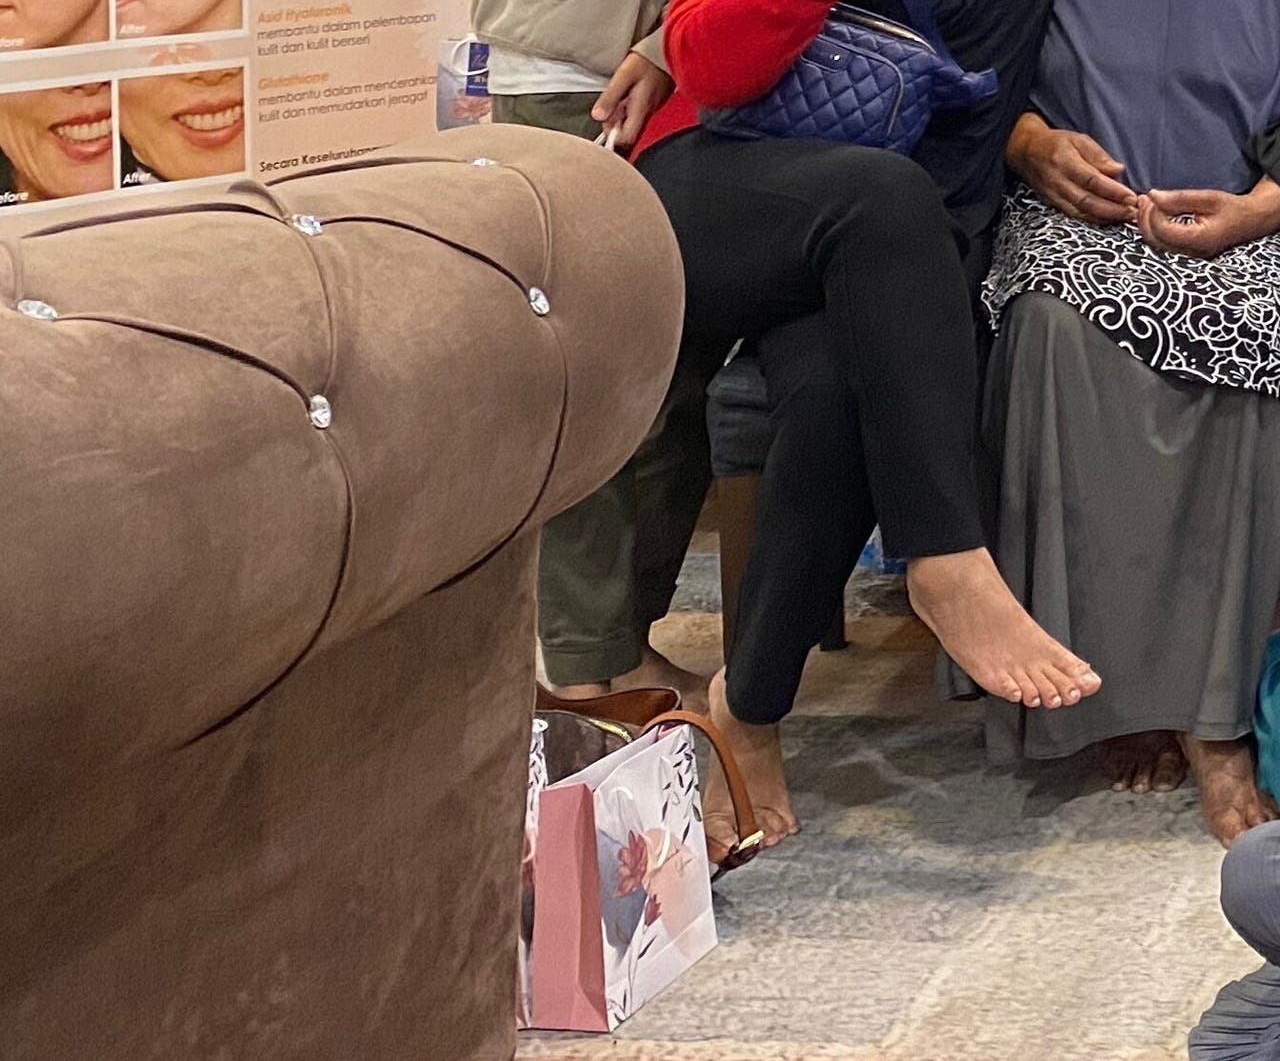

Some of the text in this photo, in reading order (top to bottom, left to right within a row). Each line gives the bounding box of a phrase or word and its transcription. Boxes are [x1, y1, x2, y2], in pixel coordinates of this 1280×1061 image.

[257, 24, 320, 40] membantu
[322, 21, 361, 33] dalam
[281, 41, 304, 53] dan
[258, 89, 321, 106] membantu
[323, 85, 362, 98] dalam
[282, 107, 306, 120] dan
[259, 157, 299, 172] Secara
[0, 190, 29, 204] efore
